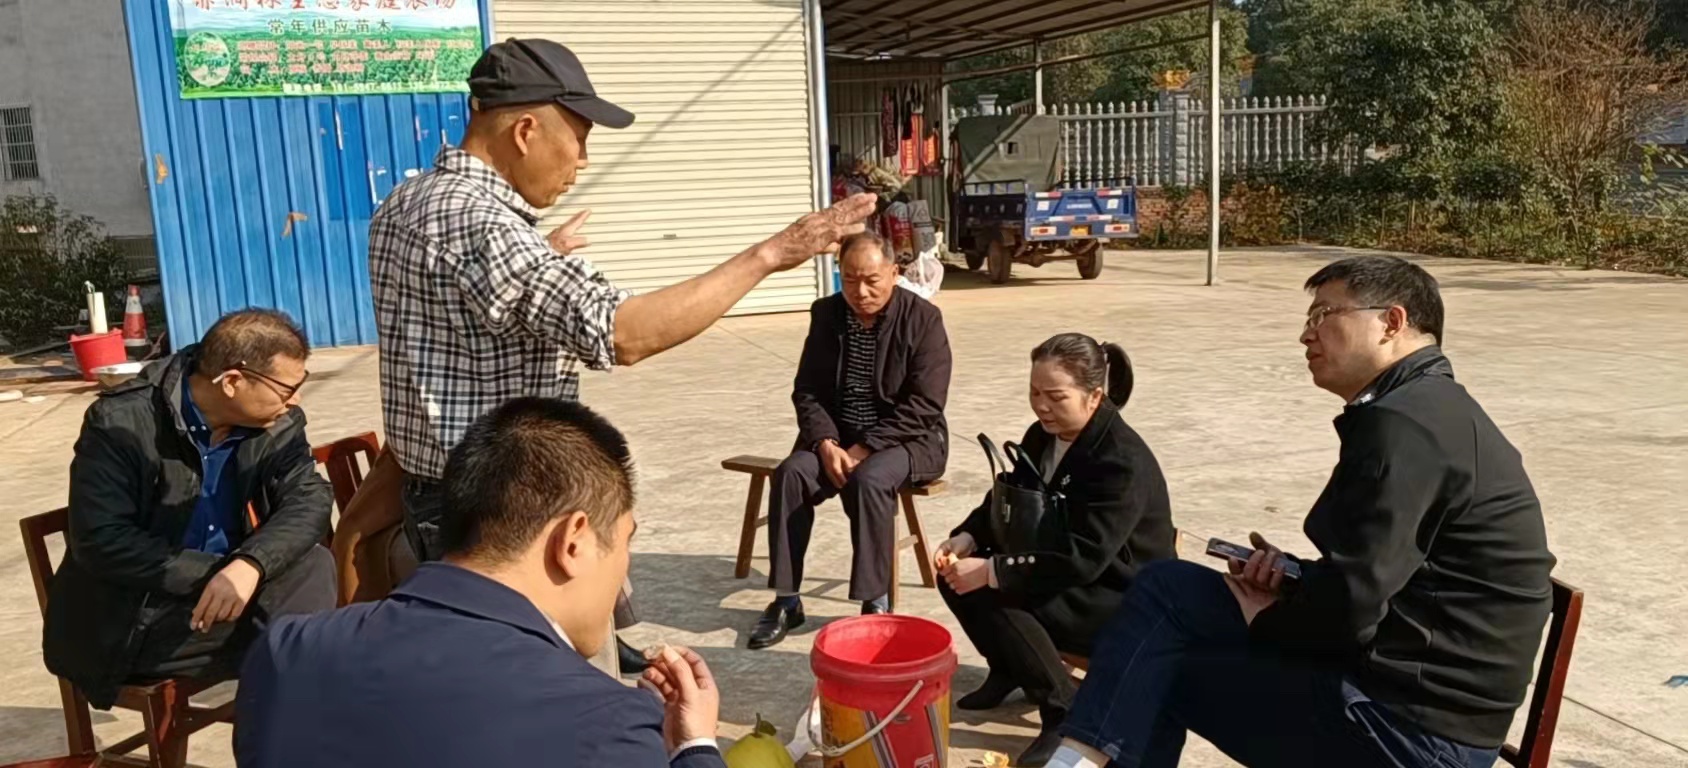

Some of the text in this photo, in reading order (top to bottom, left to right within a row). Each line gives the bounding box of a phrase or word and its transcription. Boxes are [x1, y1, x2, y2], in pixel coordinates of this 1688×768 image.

[268, 18, 391, 33] 常年供应苗木
